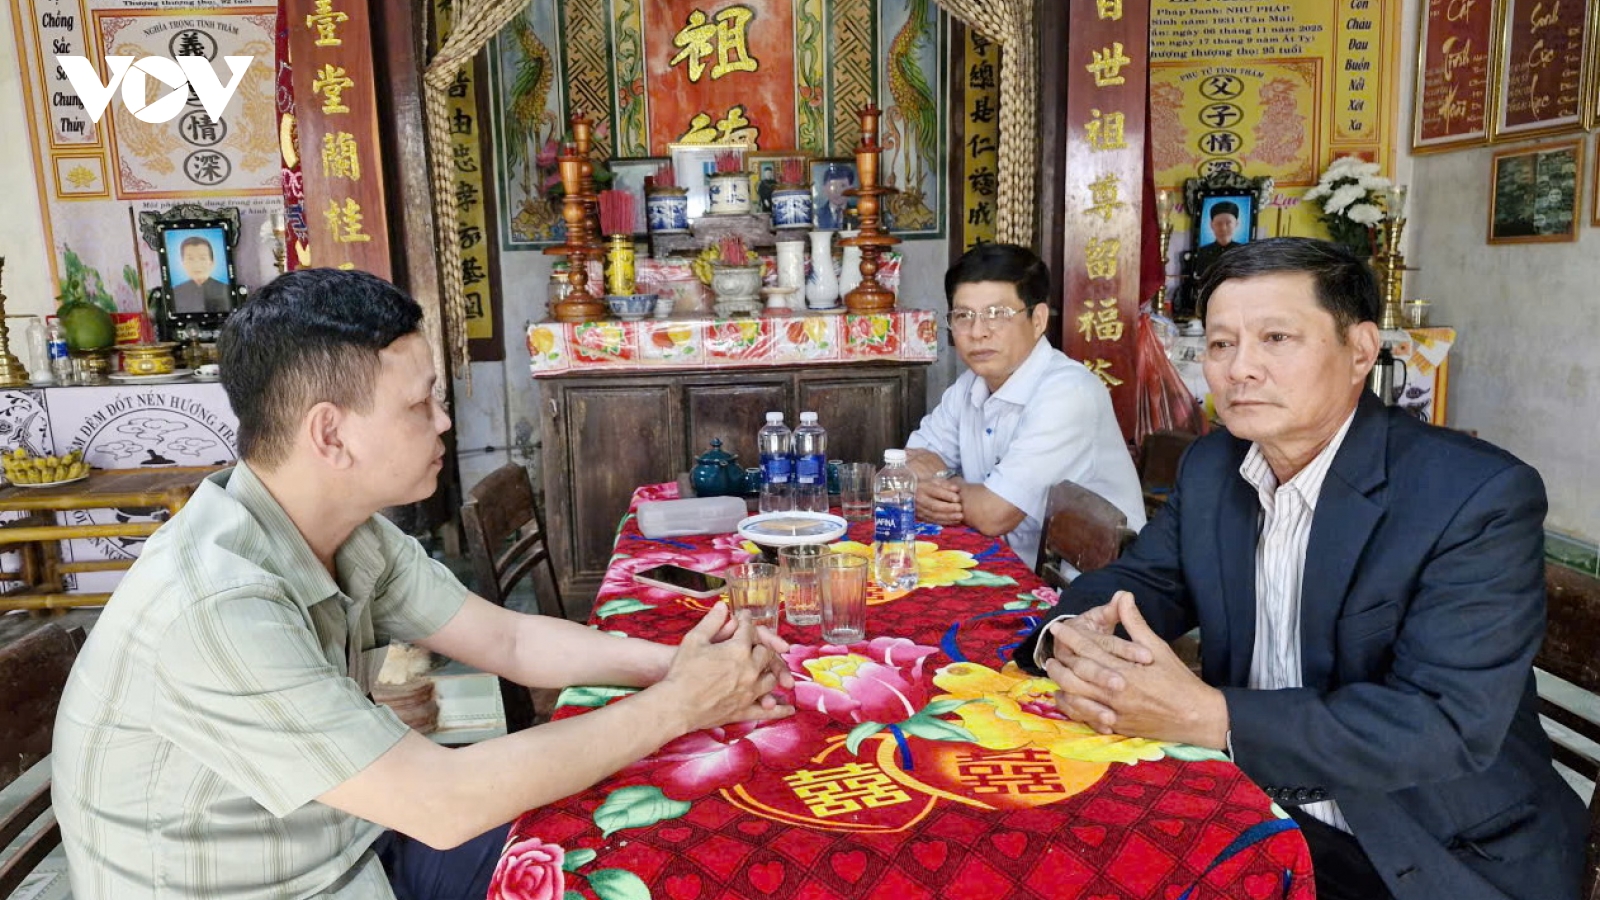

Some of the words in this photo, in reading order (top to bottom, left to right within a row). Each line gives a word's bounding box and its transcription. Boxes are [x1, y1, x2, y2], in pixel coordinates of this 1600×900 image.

[178, 32, 222, 180] 義情深
[1150, 50, 1188, 58] hượng
[305, 0, 371, 271] 臺堂蘭桂
